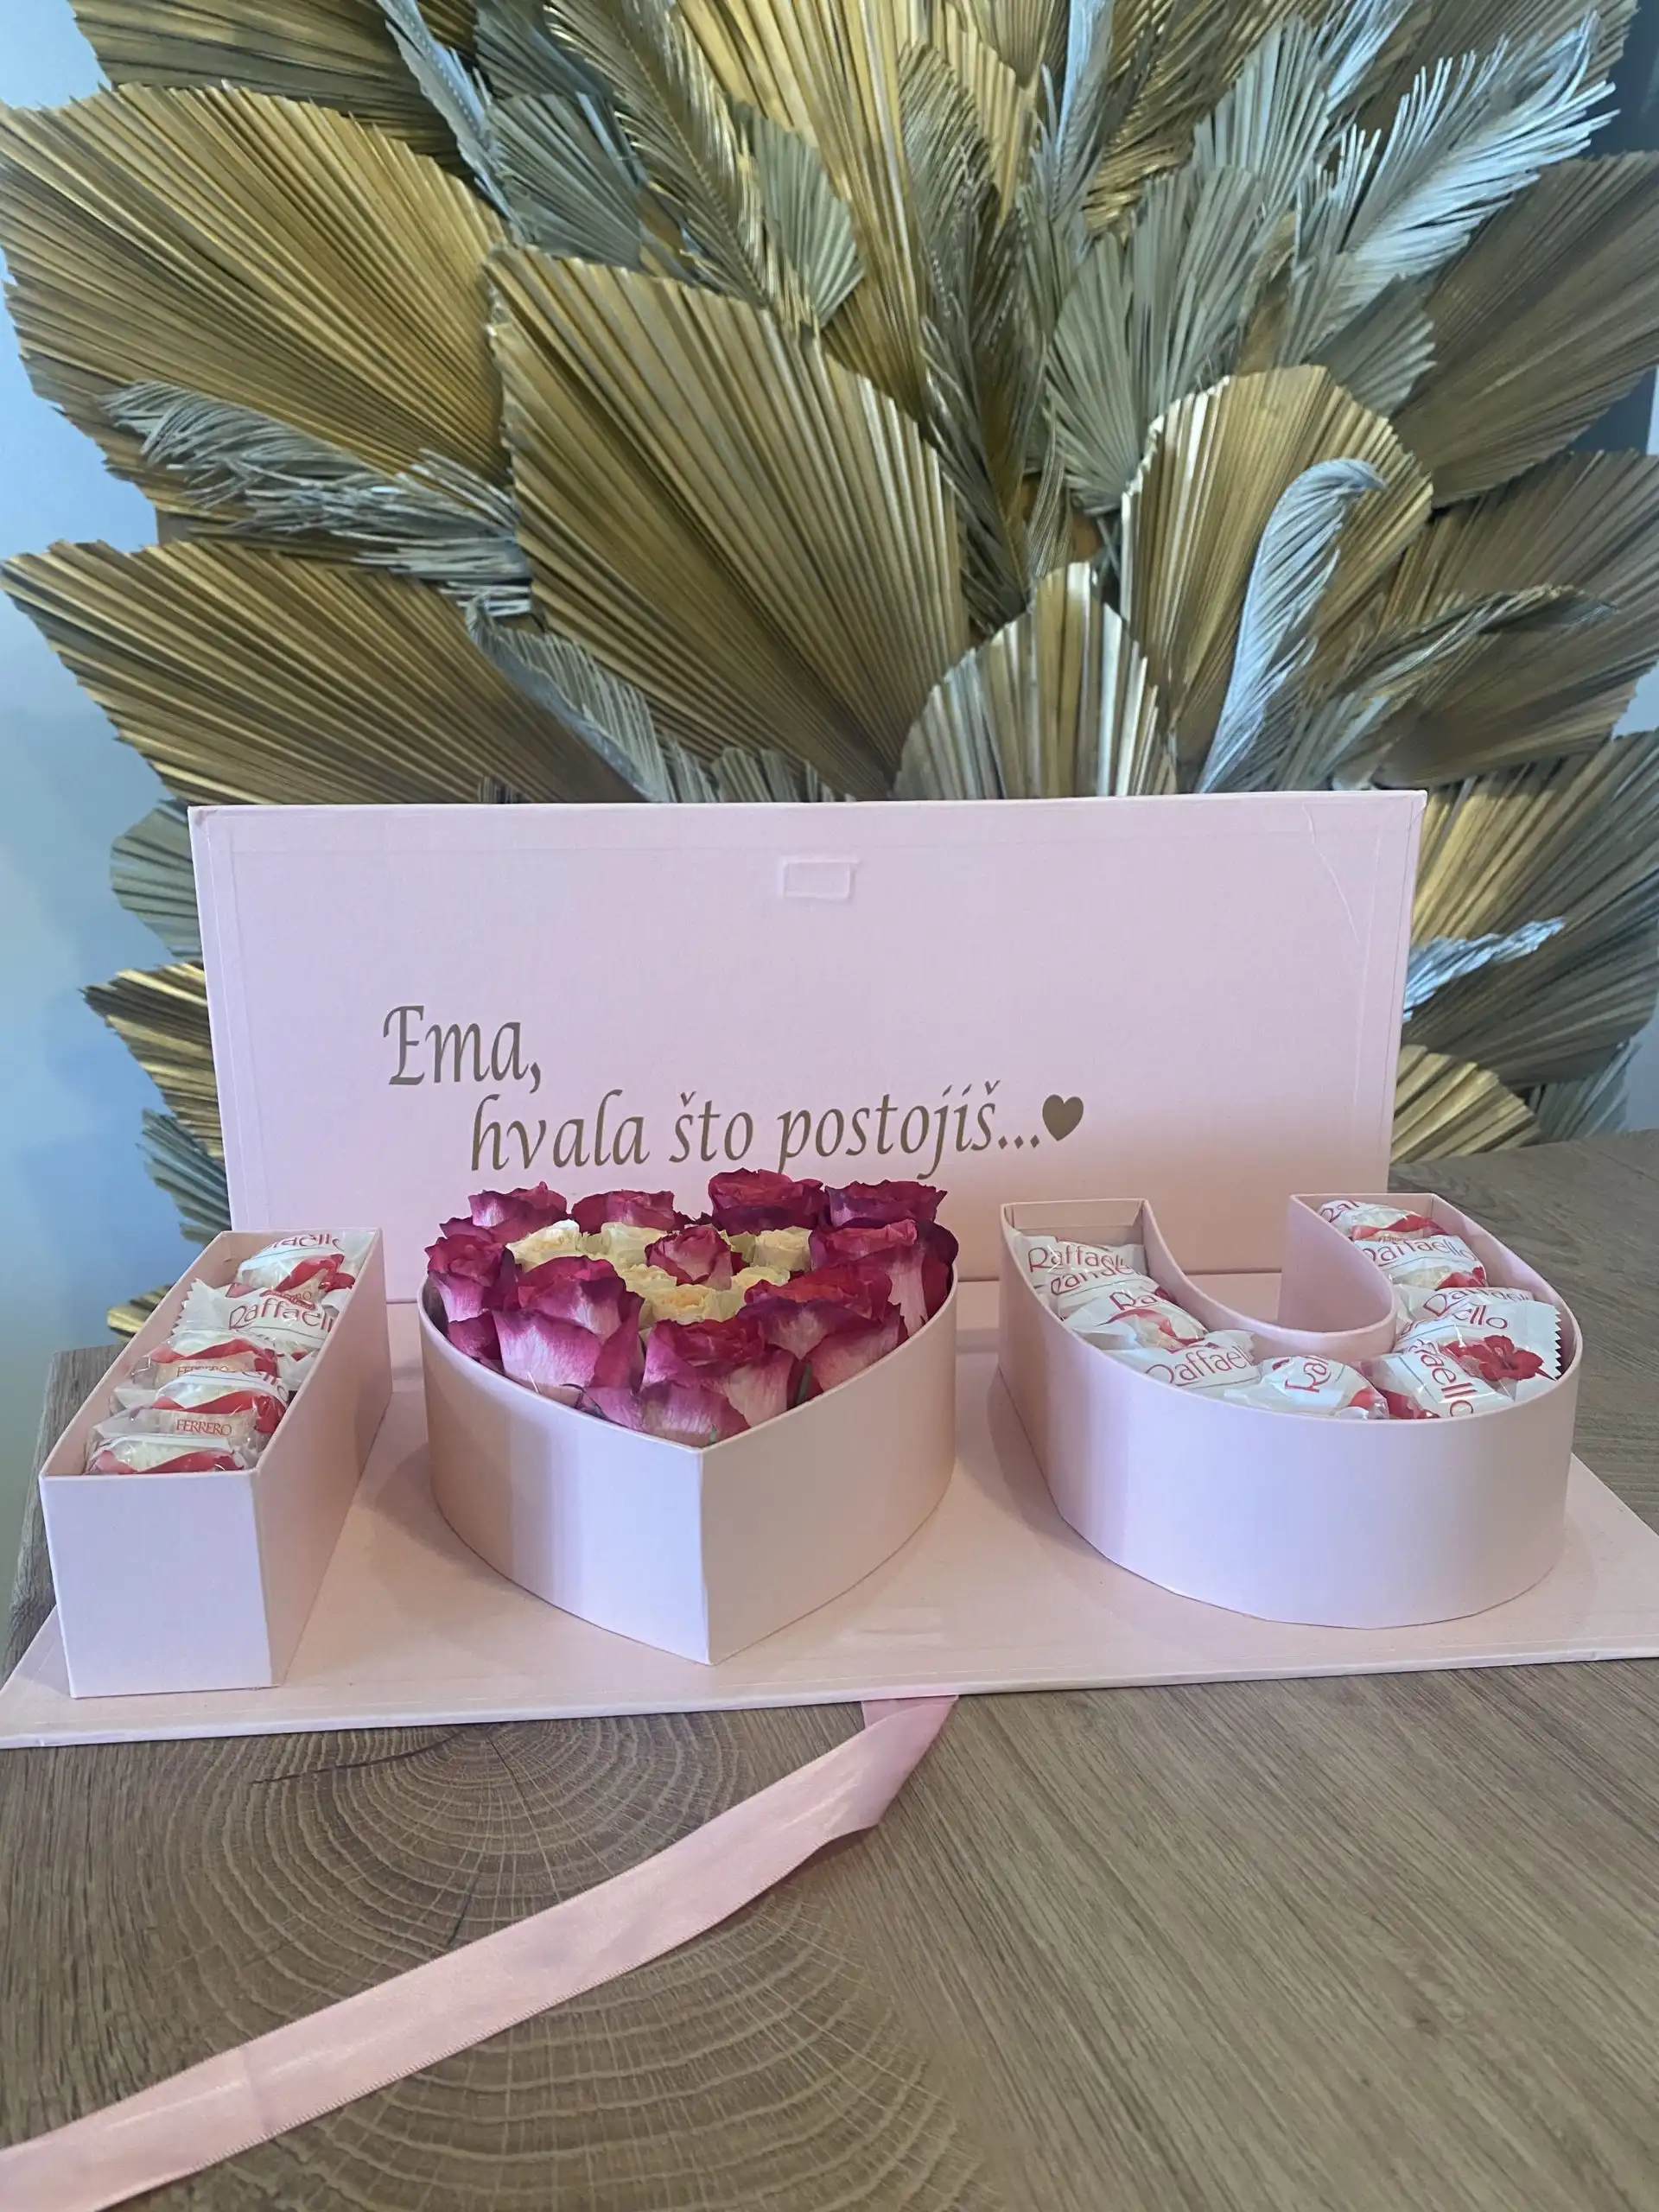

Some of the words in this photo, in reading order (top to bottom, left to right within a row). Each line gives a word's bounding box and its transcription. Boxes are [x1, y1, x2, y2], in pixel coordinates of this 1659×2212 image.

[383, 1005, 541, 1094] Ema,
[471, 1089, 651, 1172] hvala
[669, 1090, 754, 1163] što
[175, 1418, 232, 1436] FERRERO
